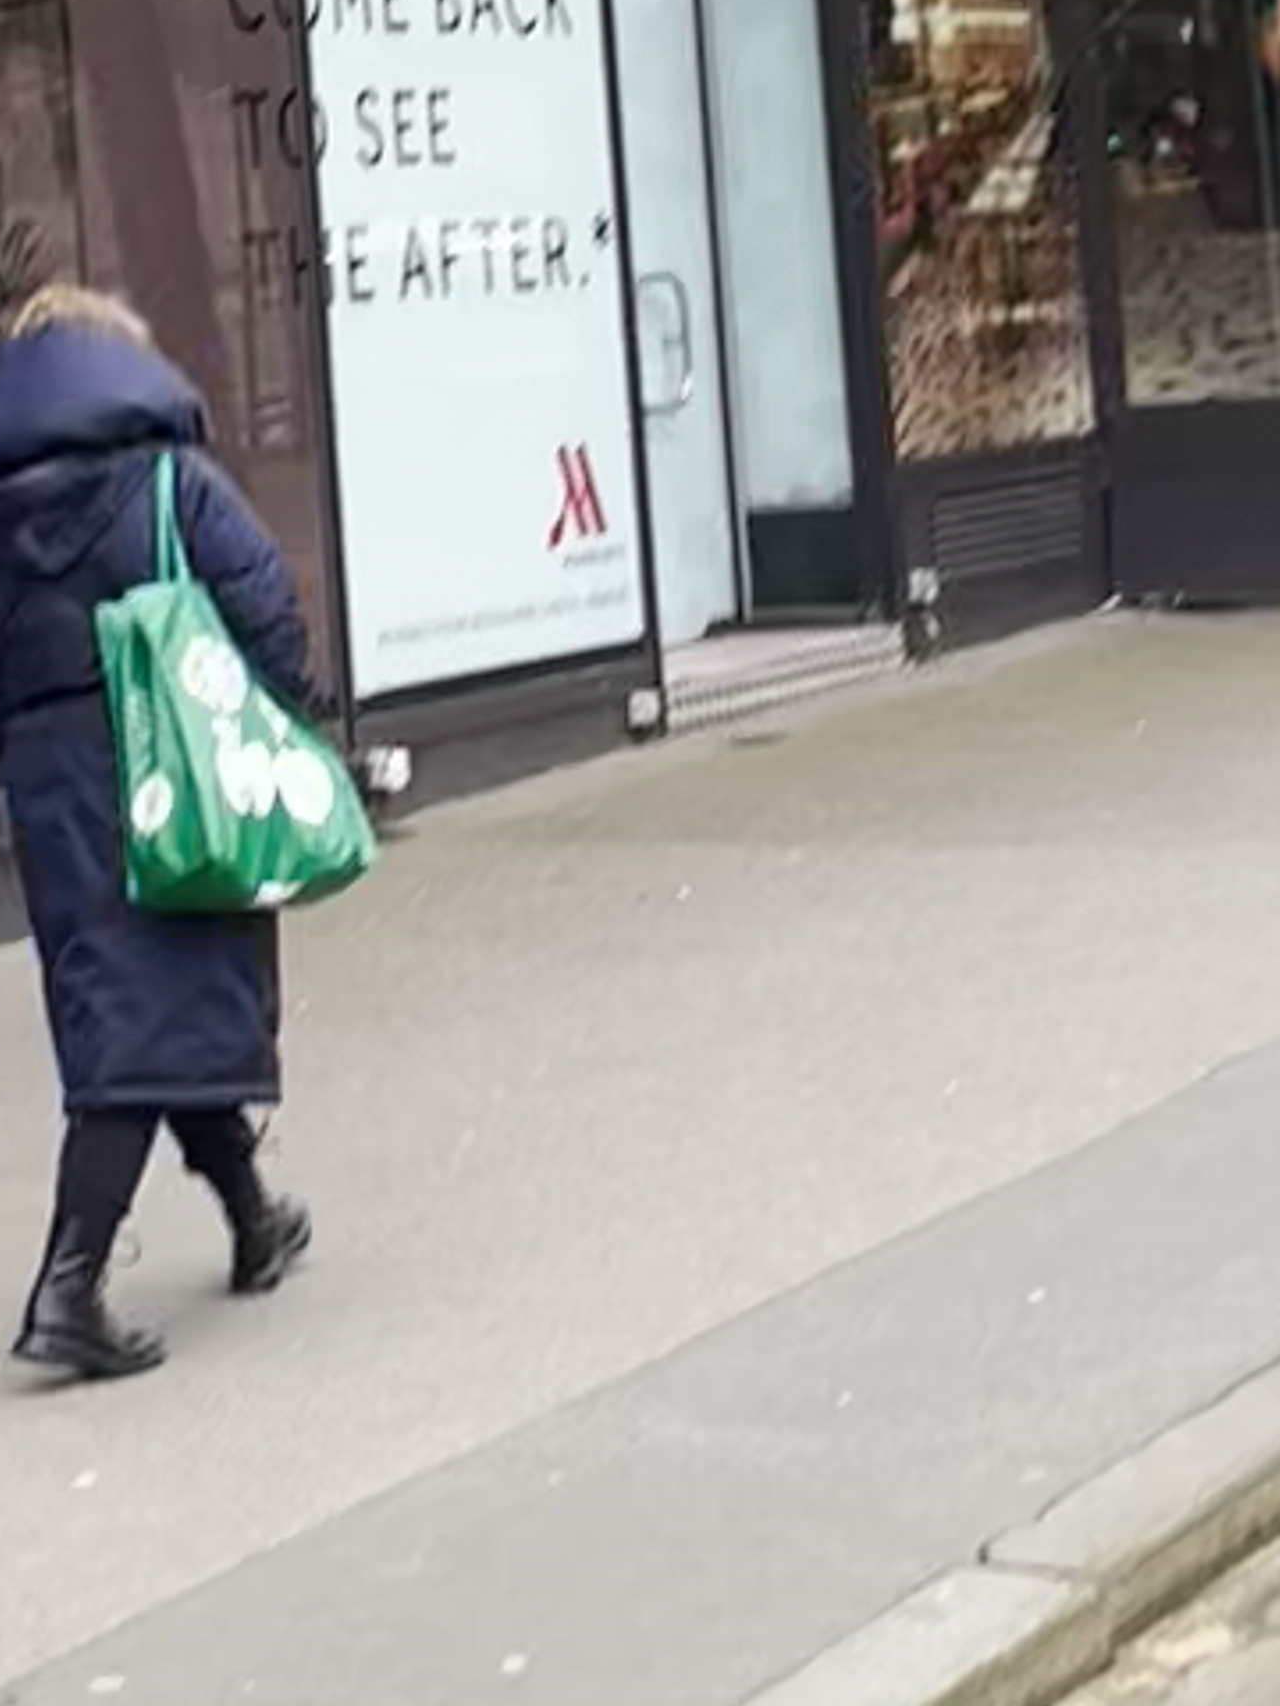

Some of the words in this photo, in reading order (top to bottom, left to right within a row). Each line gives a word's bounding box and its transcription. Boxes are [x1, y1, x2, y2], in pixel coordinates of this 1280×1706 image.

[231, 87, 328, 170] TO
[354, 87, 457, 171] SEE
[242, 224, 375, 308] THE
